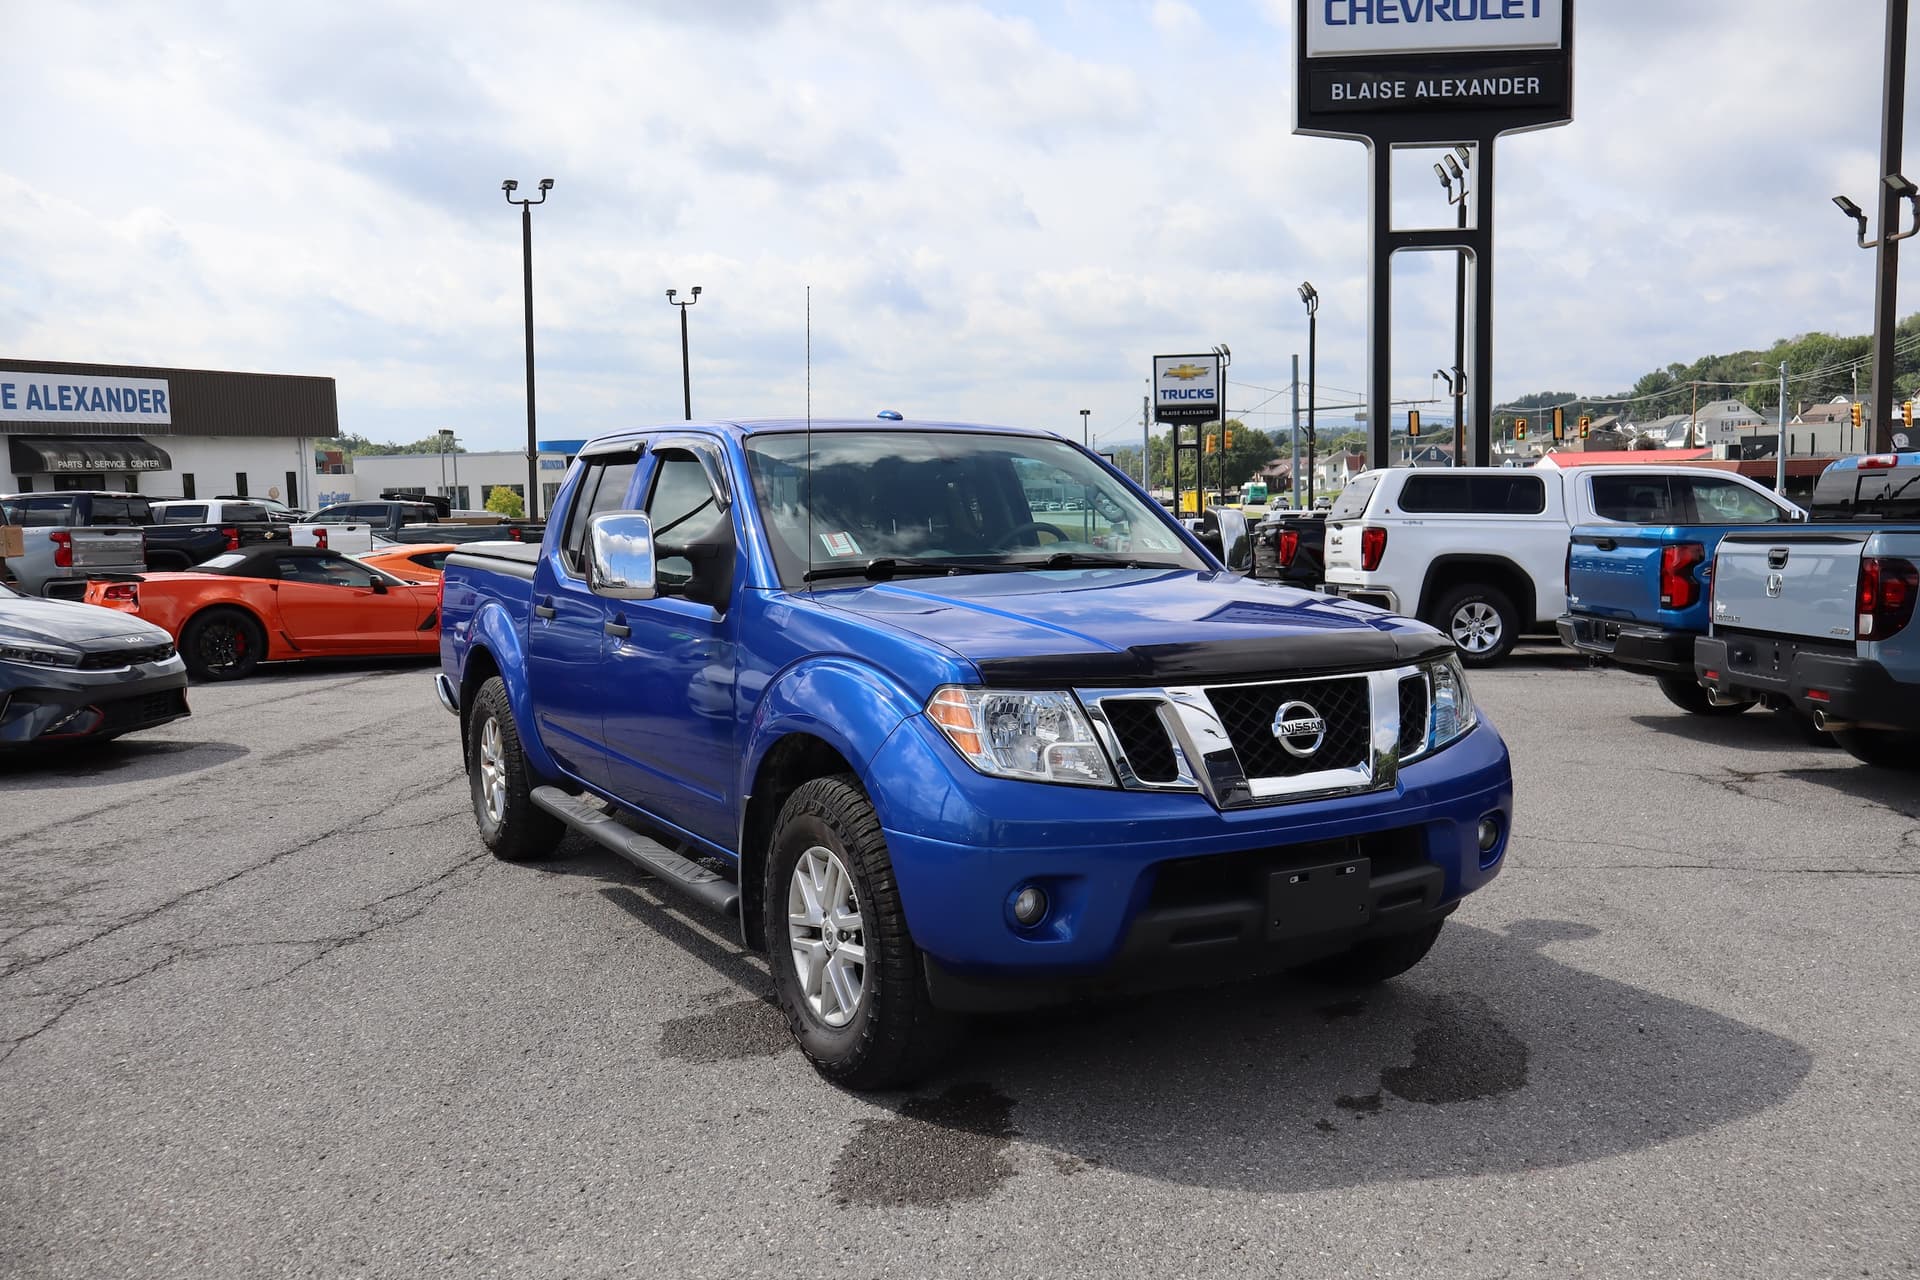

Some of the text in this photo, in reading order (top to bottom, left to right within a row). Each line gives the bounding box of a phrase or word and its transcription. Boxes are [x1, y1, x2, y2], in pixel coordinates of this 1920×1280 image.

[1331, 77, 1540, 100] BLAISE ALEXANDER
[26, 384, 168, 414] ALEXANDER
[1160, 388, 1214, 400] TRUCKS
[57, 460, 160, 468] PARTS & SERVICE CENTER
[1281, 722, 1324, 733] NISSAN
